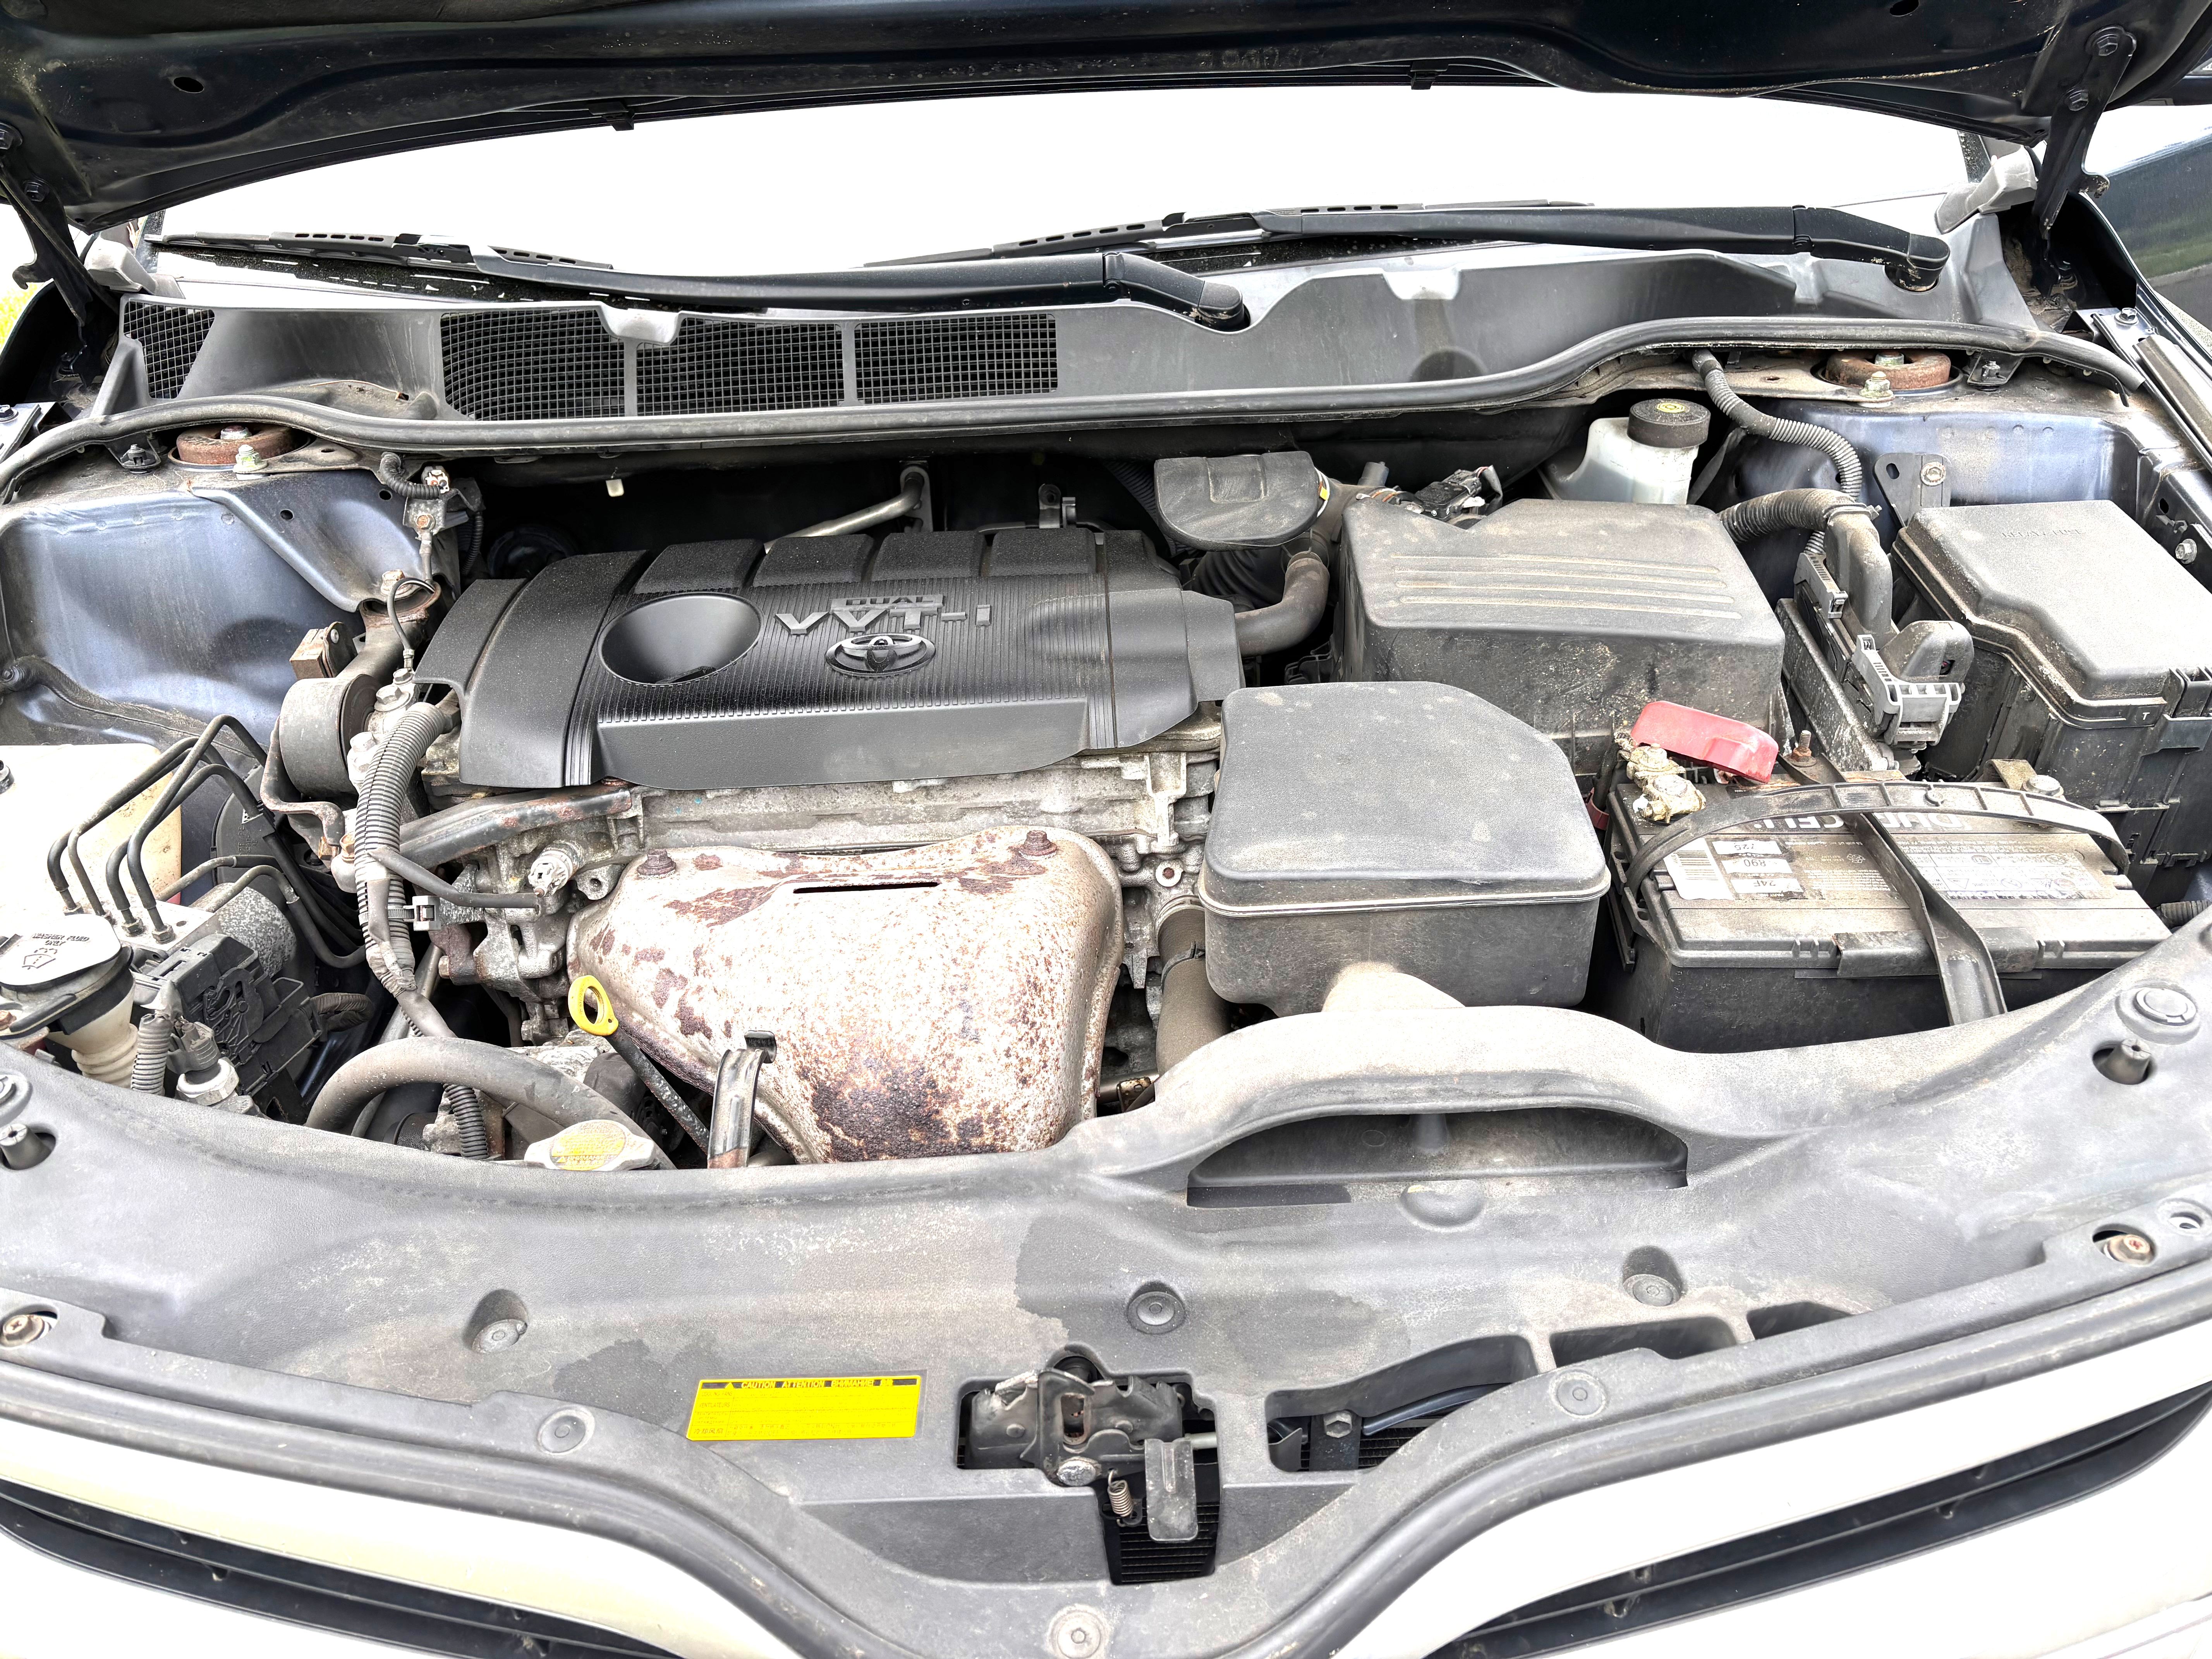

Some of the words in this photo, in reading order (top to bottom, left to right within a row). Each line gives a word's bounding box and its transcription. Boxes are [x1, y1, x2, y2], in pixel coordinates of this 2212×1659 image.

[845, 595, 934, 606] DUAL
[1743, 859, 1766, 867] 890
[781, 1380, 825, 1388] ATTENTION
